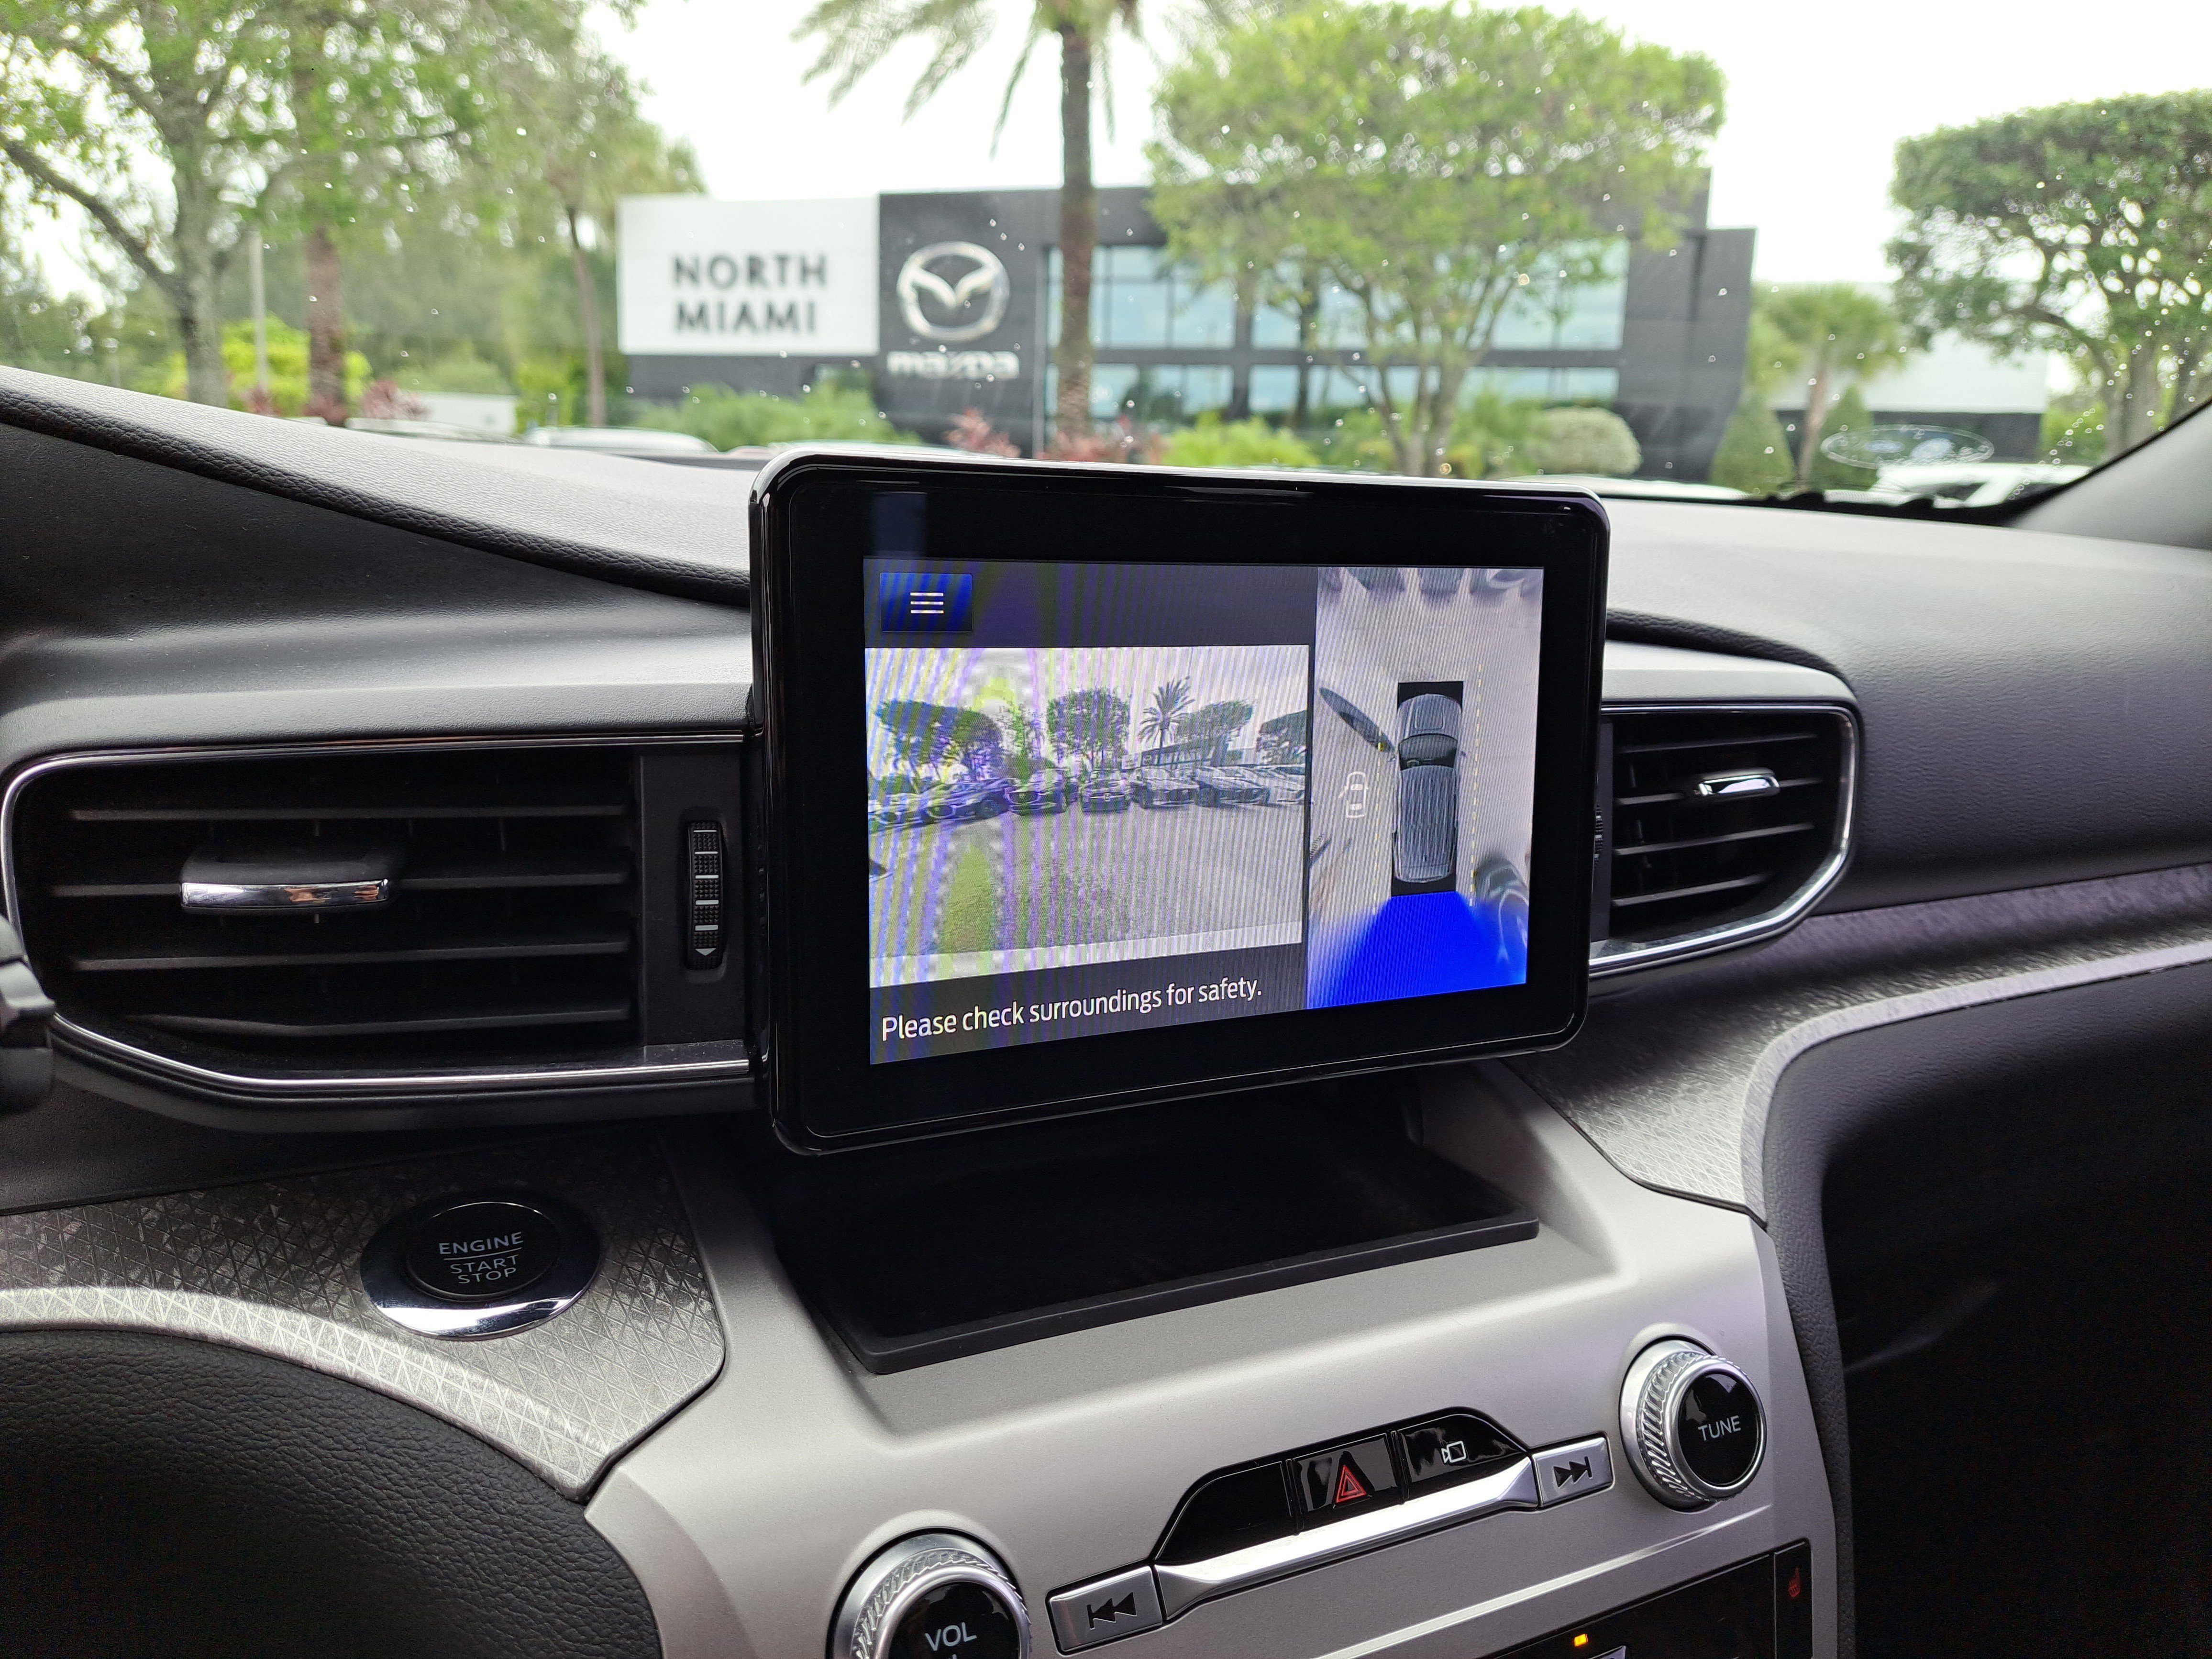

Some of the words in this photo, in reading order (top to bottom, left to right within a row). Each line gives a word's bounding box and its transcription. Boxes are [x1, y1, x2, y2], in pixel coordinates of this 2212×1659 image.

[674, 253, 827, 288] NORTH
[676, 300, 816, 334] MIAMI
[882, 1015, 957, 1041] Please
[962, 1001, 1025, 1031] check
[1029, 989, 1162, 1023] surroundings
[1166, 983, 1195, 1006] for
[1199, 976, 1262, 1002] safety.
[439, 1231, 523, 1255] ENGINE
[450, 1254, 519, 1274] START
[457, 1267, 517, 1284] STOP
[1698, 1415, 1741, 1441] TUNE
[925, 1622, 977, 1651] VOL
